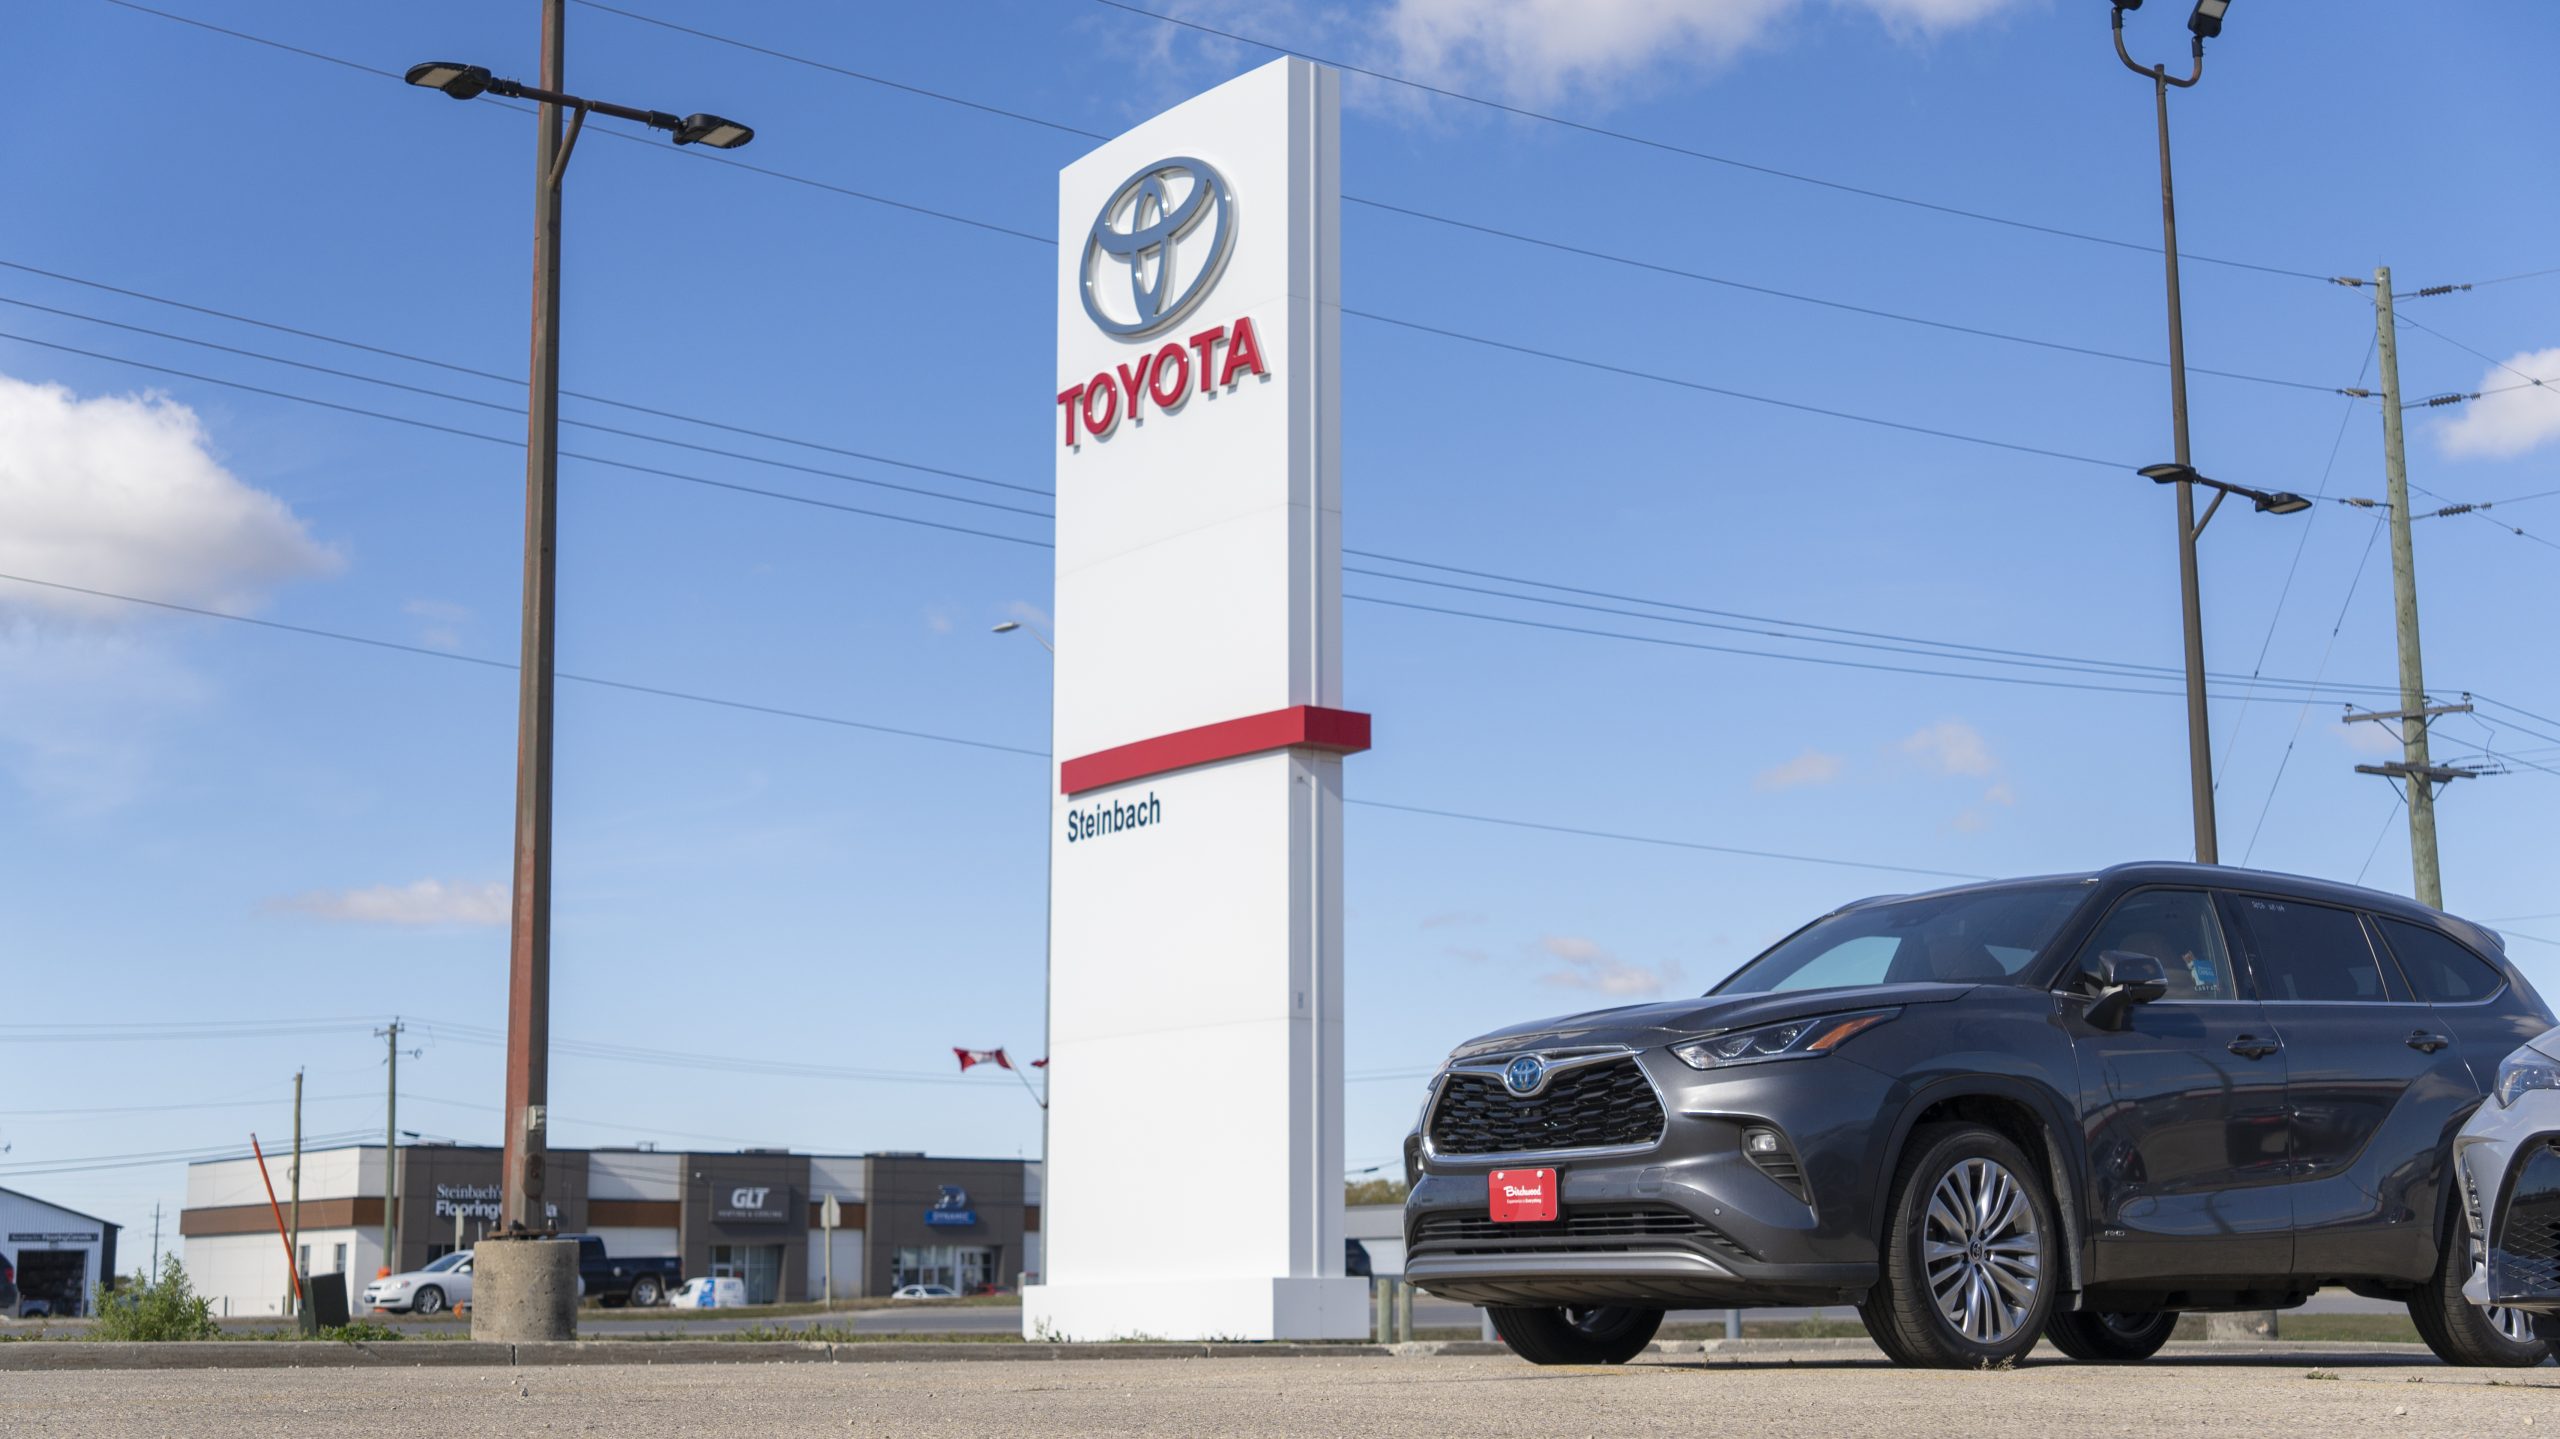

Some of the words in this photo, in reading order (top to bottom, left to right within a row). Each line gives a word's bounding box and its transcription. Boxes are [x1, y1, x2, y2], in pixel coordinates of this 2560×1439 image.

[1057, 316, 1268, 448] TOYOTA
[1067, 791, 1160, 842] Steinbach
[731, 1187, 770, 1209] GLT
